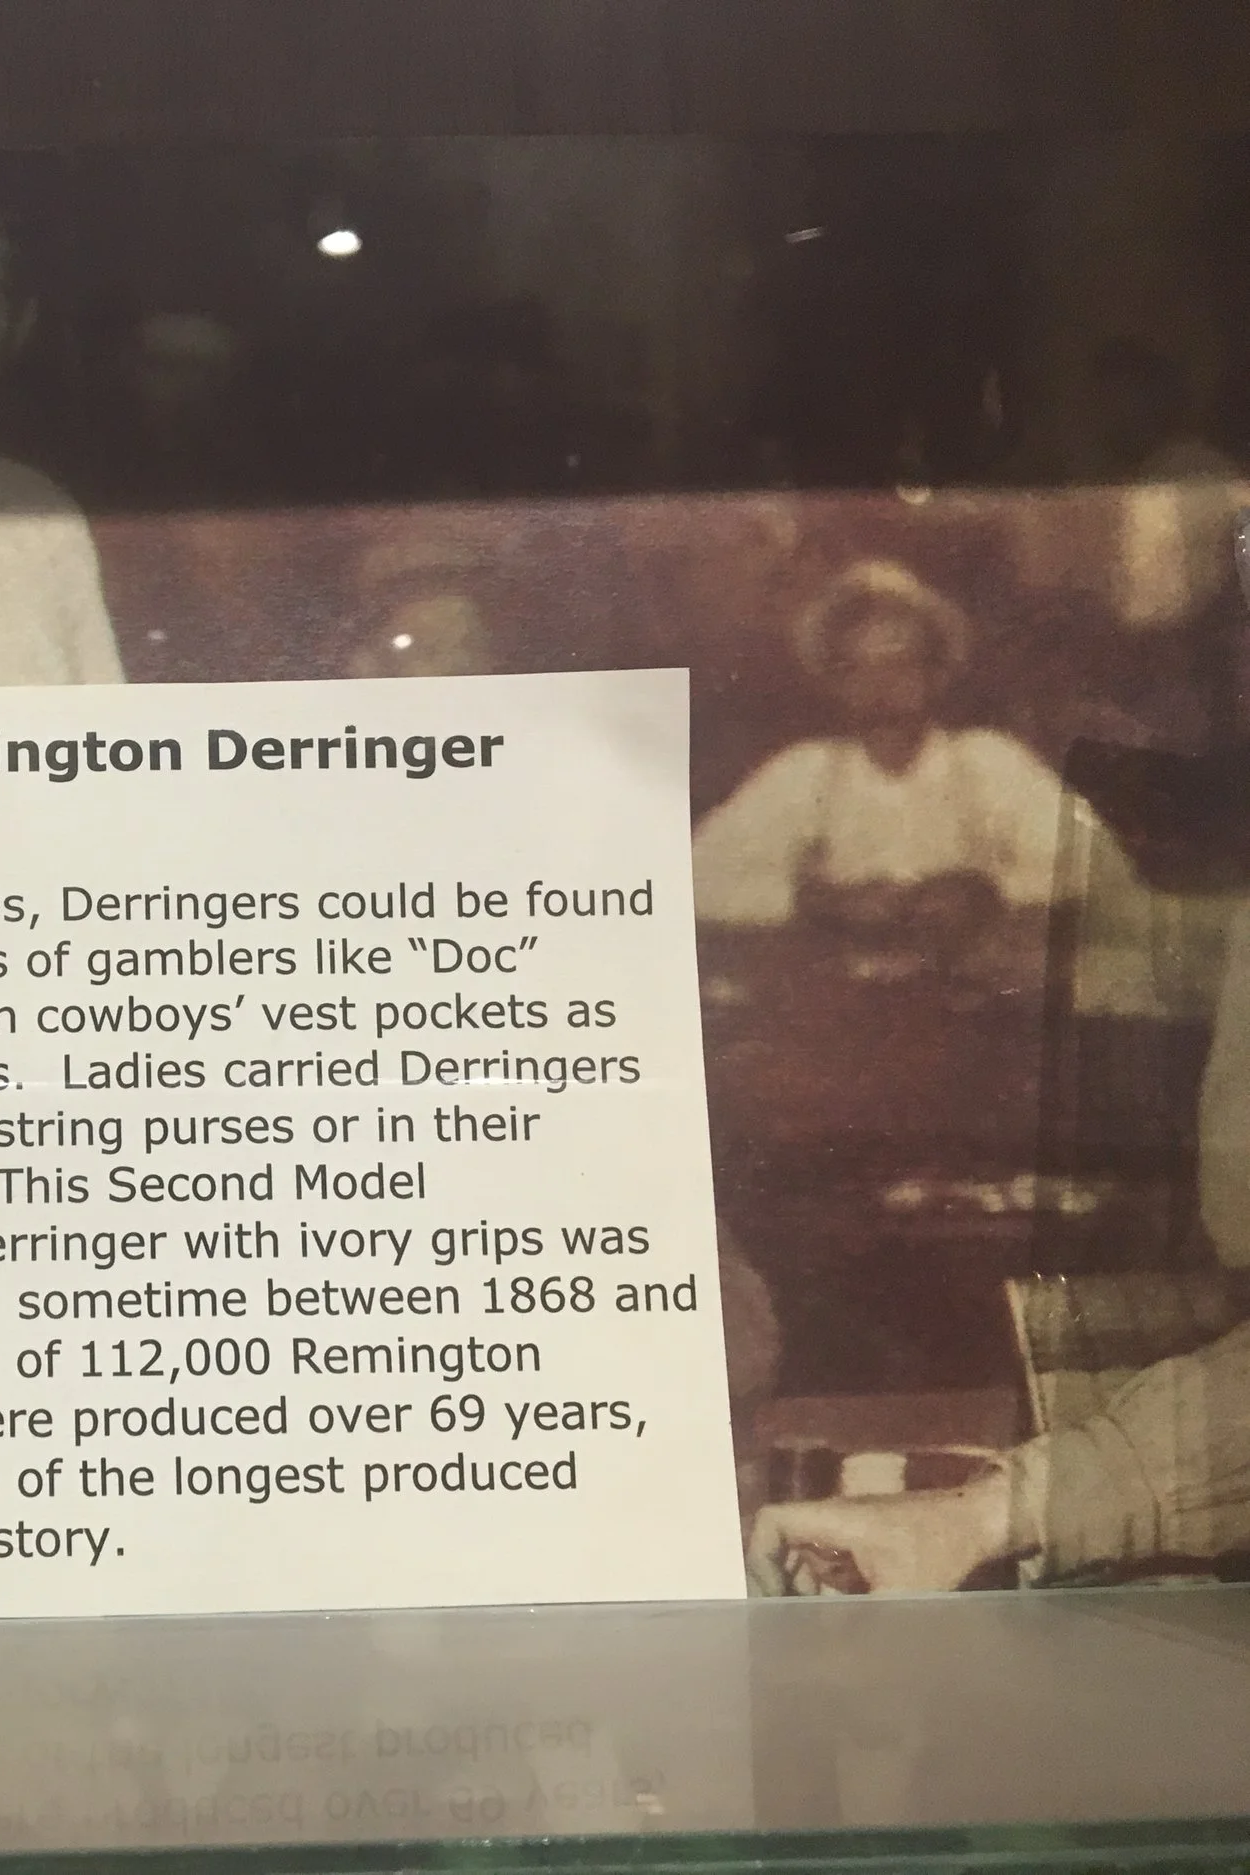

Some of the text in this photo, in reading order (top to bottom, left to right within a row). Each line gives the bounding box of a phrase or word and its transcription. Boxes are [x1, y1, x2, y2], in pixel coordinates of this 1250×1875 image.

[207, 724, 505, 780] Derringer
[62, 885, 300, 930] Derringers
[318, 881, 435, 920] could
[456, 881, 508, 919] be
[526, 879, 653, 918] found
[26, 940, 72, 978] of
[87, 938, 297, 986] gamblers
[316, 937, 392, 975] like
[261, 995, 357, 1031] vest
[375, 992, 548, 1039] pockets
[567, 999, 617, 1029] as
[64, 1051, 206, 1090] Ladies
[224, 1049, 379, 1088] carried
[400, 1049, 641, 1094] Derringers
[145, 1115, 294, 1155] purses
[312, 1115, 360, 1144] or
[377, 1106, 415, 1143] in
[433, 1104, 541, 1143] their
[108, 1162, 273, 1203] Second
[295, 1161, 425, 1201] Model
[183, 1220, 279, 1259] with
[300, 1221, 413, 1267] ivory
[431, 1219, 544, 1266] grips
[560, 1225, 650, 1255] was
[18, 1280, 247, 1320] sometime
[267, 1277, 460, 1317] between
[483, 1275, 596, 1314] 1868
[615, 1273, 697, 1313] and
[16, 1338, 62, 1379] of
[81, 1337, 270, 1385] 112,000
[292, 1336, 541, 1383] Remington
[74, 1395, 288, 1447] produced
[308, 1403, 413, 1434] over
[430, 1393, 485, 1433] 69
[504, 1400, 647, 1441] years,
[17, 1457, 64, 1498] of
[79, 1457, 155, 1498] the
[175, 1455, 345, 1505] longest
[364, 1450, 577, 1503] produced
